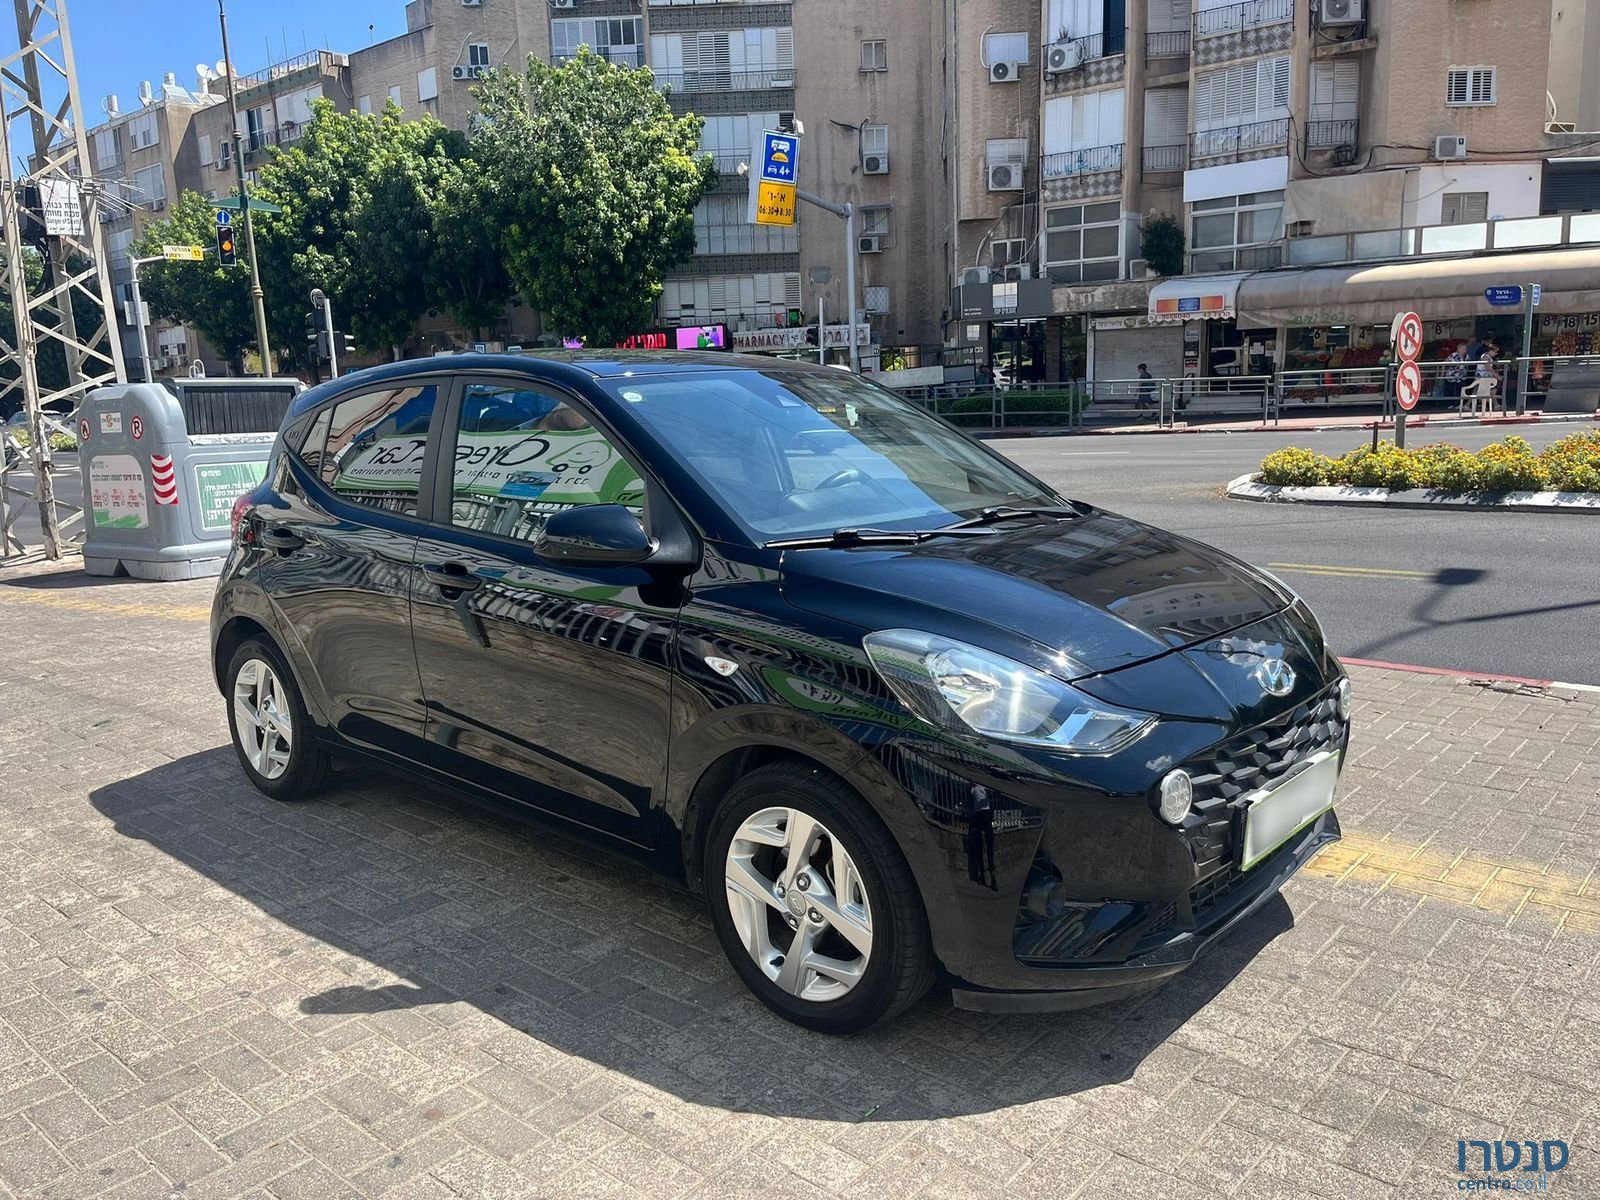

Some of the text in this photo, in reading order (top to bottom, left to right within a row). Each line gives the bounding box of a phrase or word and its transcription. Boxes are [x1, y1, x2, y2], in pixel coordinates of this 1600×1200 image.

[1563, 318, 1576, 328] 18
[1584, 314, 1598, 326] 15
[733, 334, 785, 348] PHARMACY
